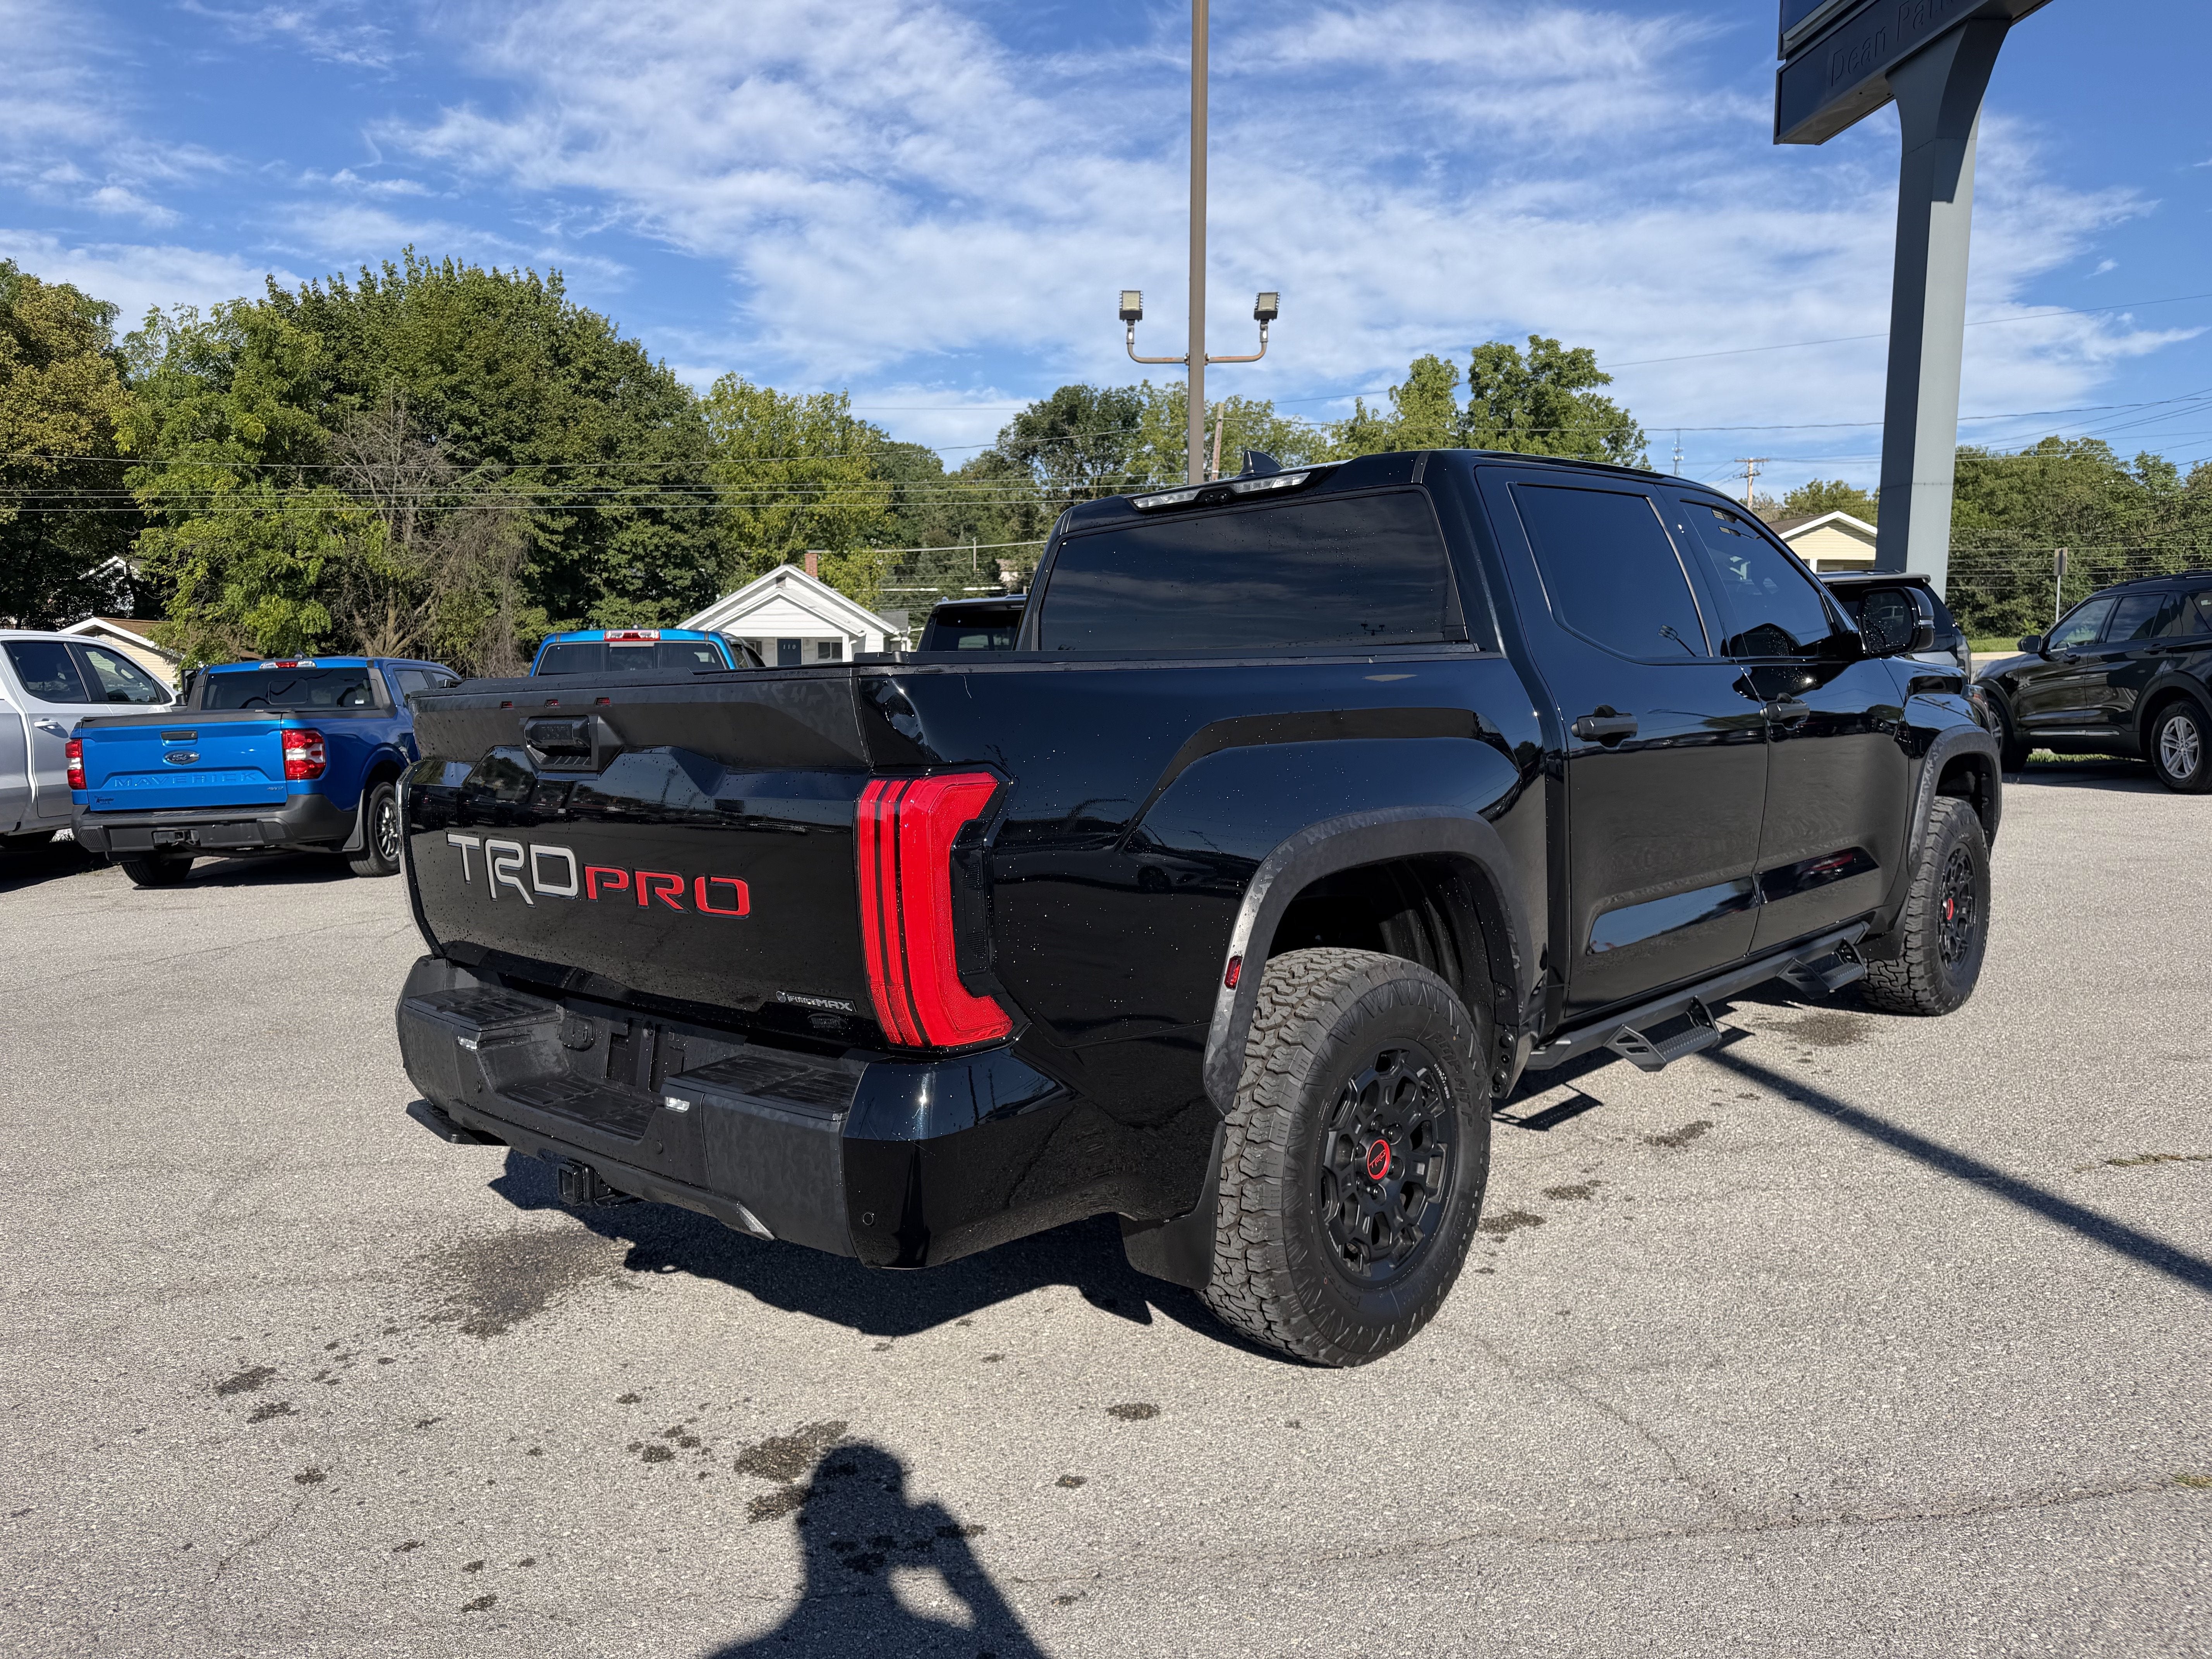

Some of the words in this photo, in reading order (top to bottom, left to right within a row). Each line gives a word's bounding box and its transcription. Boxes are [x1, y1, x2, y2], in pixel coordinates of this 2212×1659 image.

[1831, 26, 1886, 87] Dean
[114, 773, 257, 788] MAVERICK
[447, 832, 579, 909] TRD
[584, 864, 751, 920] PRO
